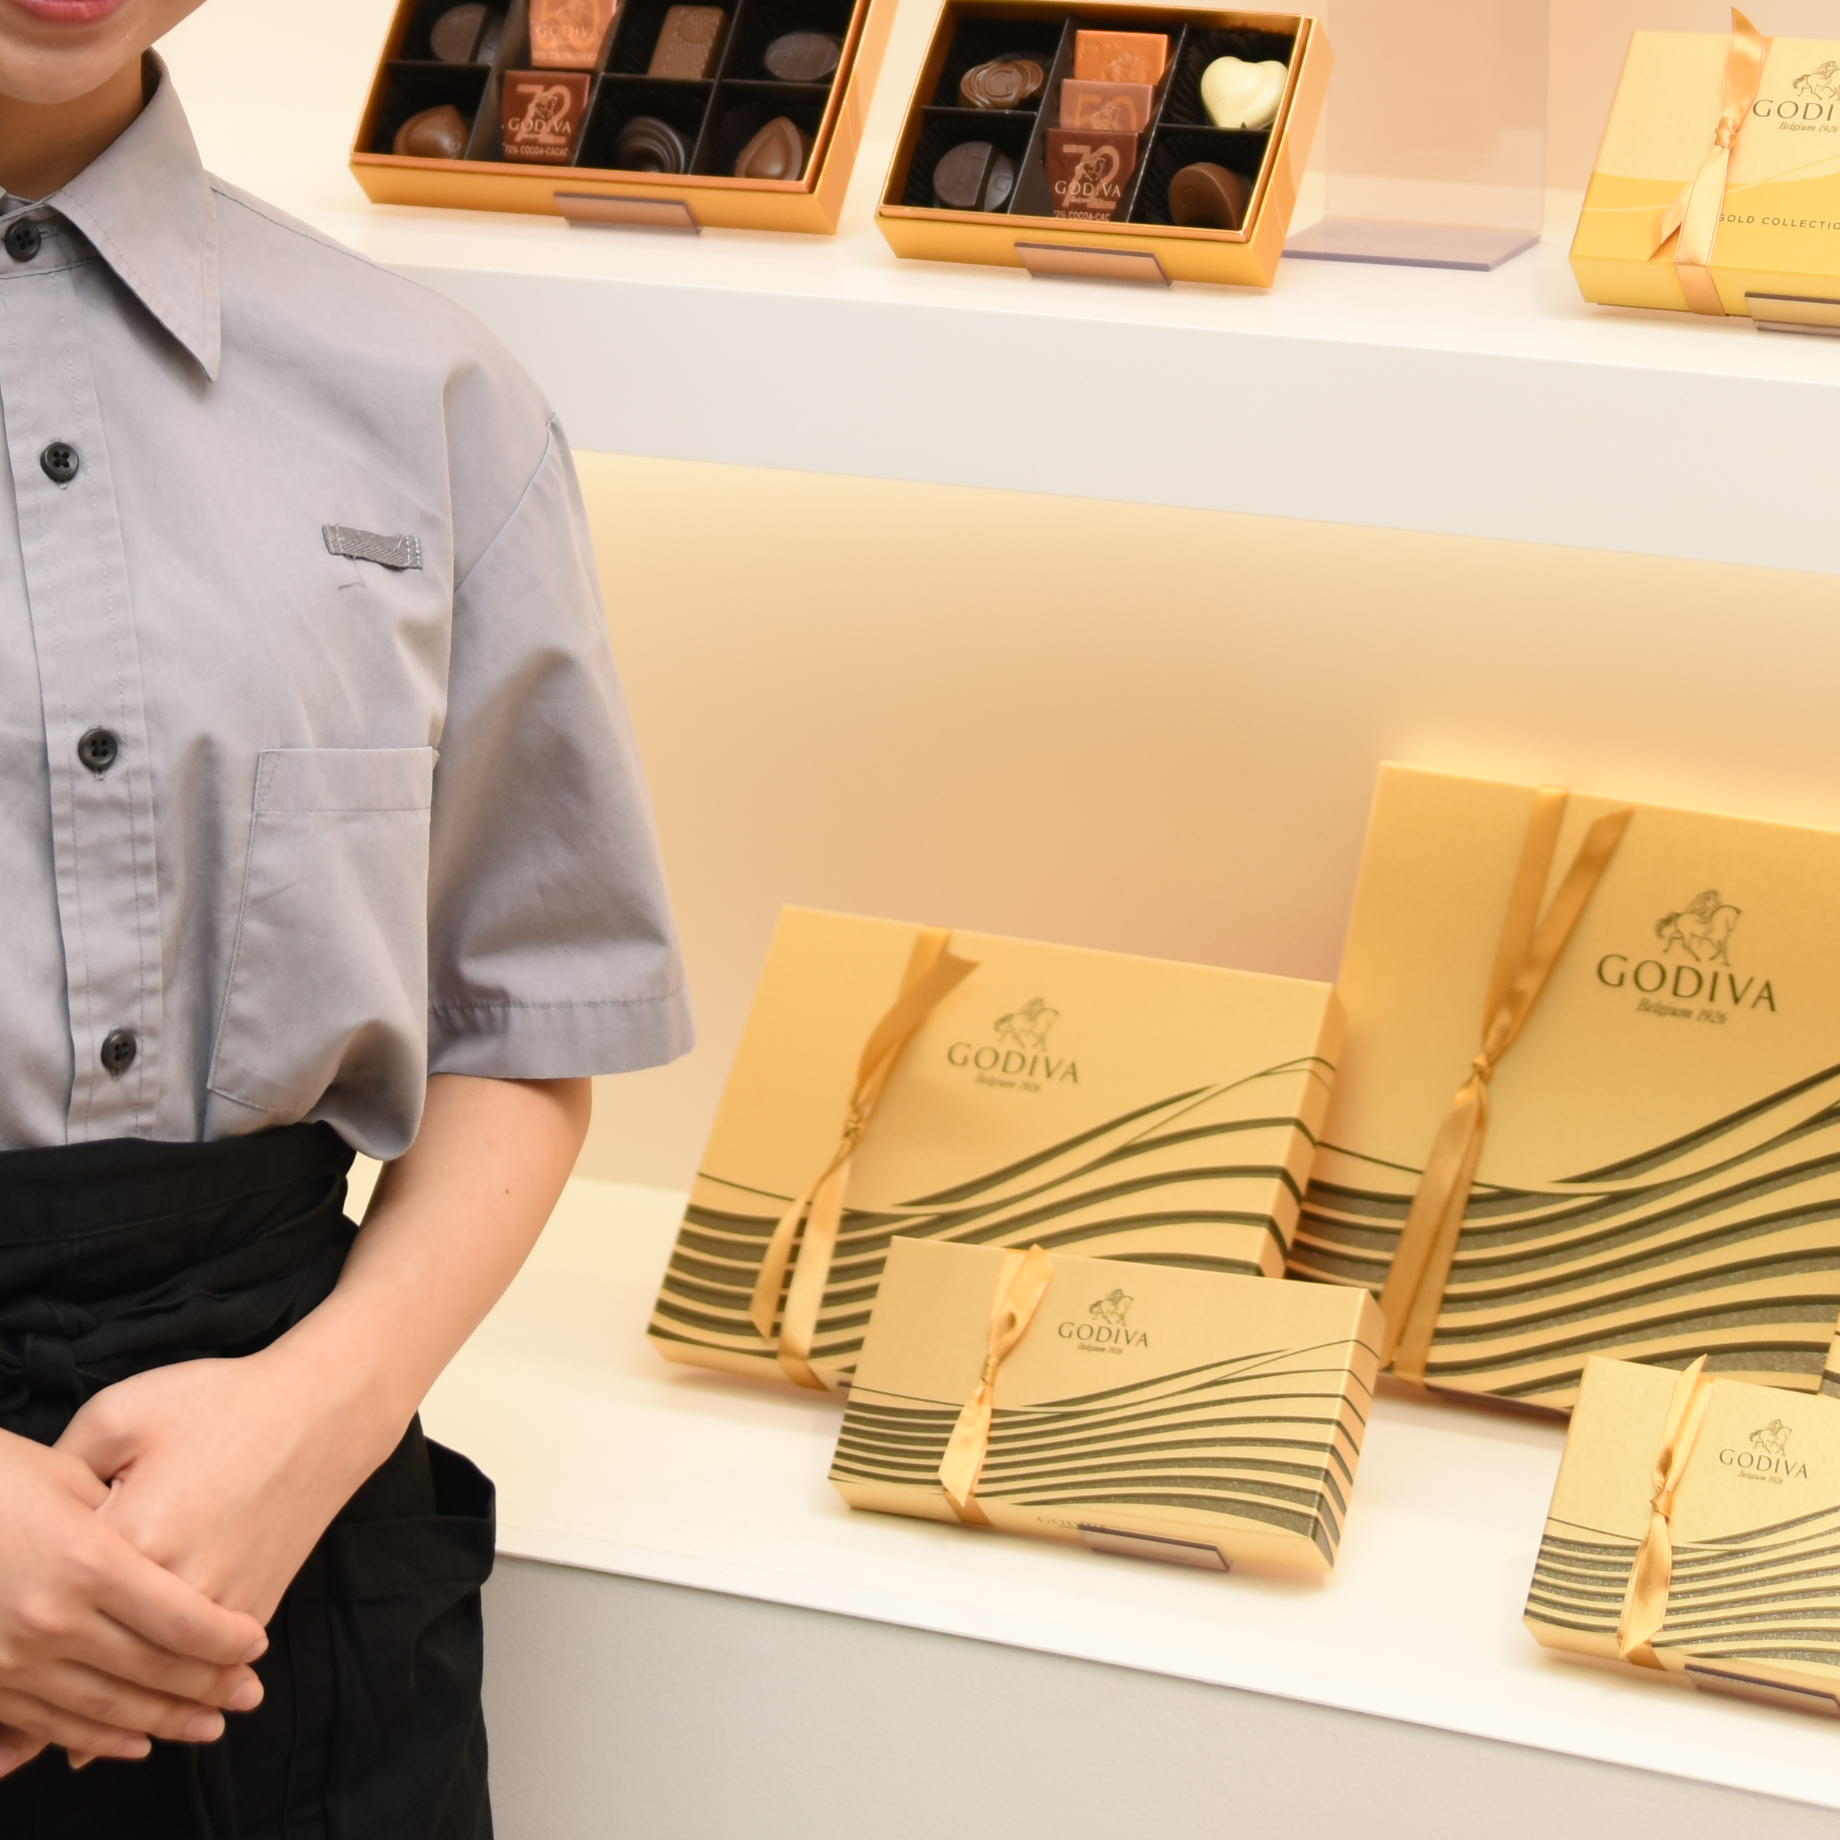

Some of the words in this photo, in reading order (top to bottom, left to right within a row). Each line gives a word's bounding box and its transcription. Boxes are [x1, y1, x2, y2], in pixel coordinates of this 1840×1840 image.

[508, 116, 572, 136] GODIVA
[513, 83, 572, 145] 72
[1777, 120, 1818, 133] Belgium
[1054, 180, 1121, 199] GODIVA
[1061, 144, 1120, 209] 72
[1596, 953, 1777, 1012] GODIVA
[946, 1041, 1079, 1084] GODIVA
[1057, 1321, 1149, 1348] GODIVA
[1718, 1448, 1808, 1480] GODIVA
